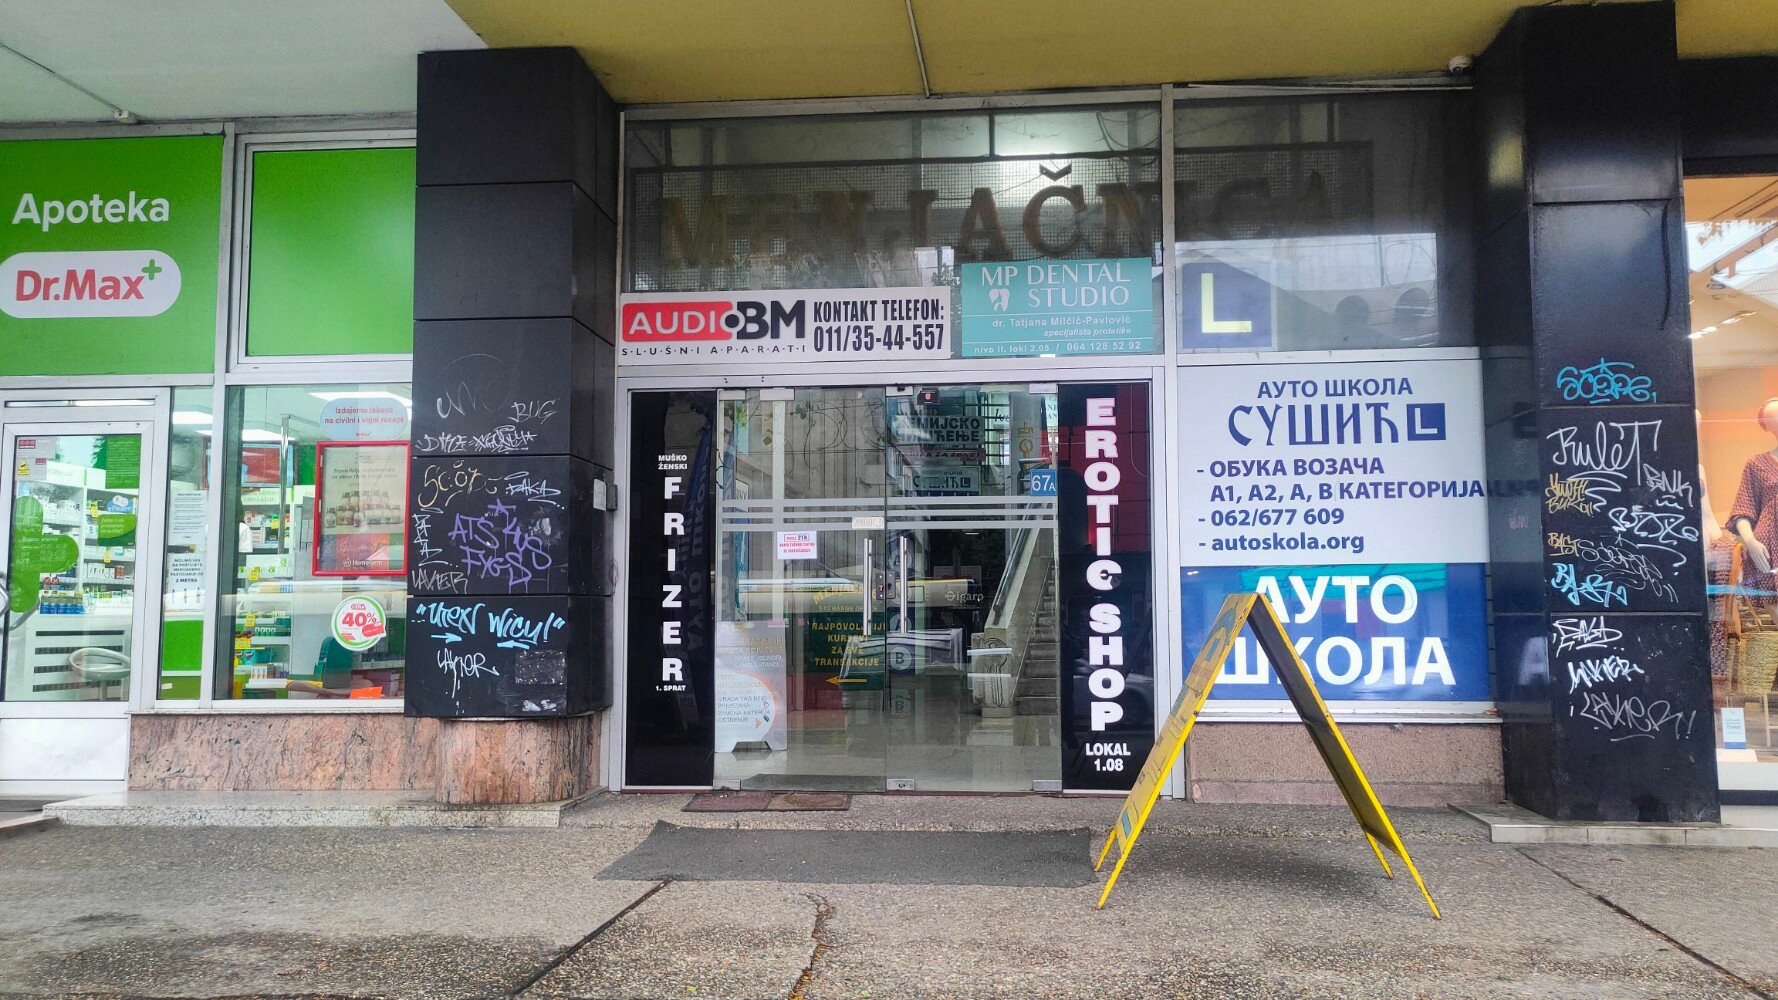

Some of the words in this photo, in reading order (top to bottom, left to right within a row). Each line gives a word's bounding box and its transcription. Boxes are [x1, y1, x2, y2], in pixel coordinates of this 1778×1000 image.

[12, 191, 170, 232] Apoteka
[16, 269, 145, 302] Dr.Max
[981, 266, 1018, 287] MP
[1027, 262, 1132, 285] DENTAL
[1028, 286, 1130, 308] STUDIO
[1201, 273, 1252, 334] L
[813, 300, 878, 323] KONTAKT
[882, 298, 945, 322] TELEFON:
[992, 318, 1006, 328] dr.
[1009, 318, 1047, 329] Tatjana
[813, 323, 945, 353] 011/35-44-557
[974, 345, 994, 354] nivo
[1030, 344, 1050, 352] 2.05
[1066, 342, 1086, 351] 064
[1089, 341, 1108, 350] 128
[1112, 341, 1125, 350] 52
[1128, 340, 1142, 350] 92
[1257, 380, 1318, 399] АУТО
[1324, 377, 1413, 398] ШКОЛА
[1228, 402, 1399, 447] СУШИЋ
[658, 454, 687, 462] MUŠKO
[658, 462, 688, 470] ŽENSKI
[1209, 459, 1287, 478] ОБУКА
[1293, 456, 1385, 476] ВОЗАЧА
[1083, 397, 1122, 591] EROTIC
[1210, 484, 1242, 504] А1,
[1247, 484, 1284, 503] А2,
[1290, 483, 1313, 503] А,
[1319, 482, 1333, 500] В
[1339, 480, 1485, 500] КАТЕГОРИЈА
[1210, 508, 1297, 528] 062/677
[1303, 507, 1345, 526] 609
[1211, 532, 1365, 554] autoskola.org
[662, 476, 686, 682] FRIZER
[1253, 574, 1418, 625] АУТО
[342, 612, 377, 627] 40%
[831, 646, 843, 654] ZA
[1087, 603, 1127, 732] SHOP
[1085, 742, 1131, 757] LOKAL
[1093, 758, 1124, 772] 1.08
